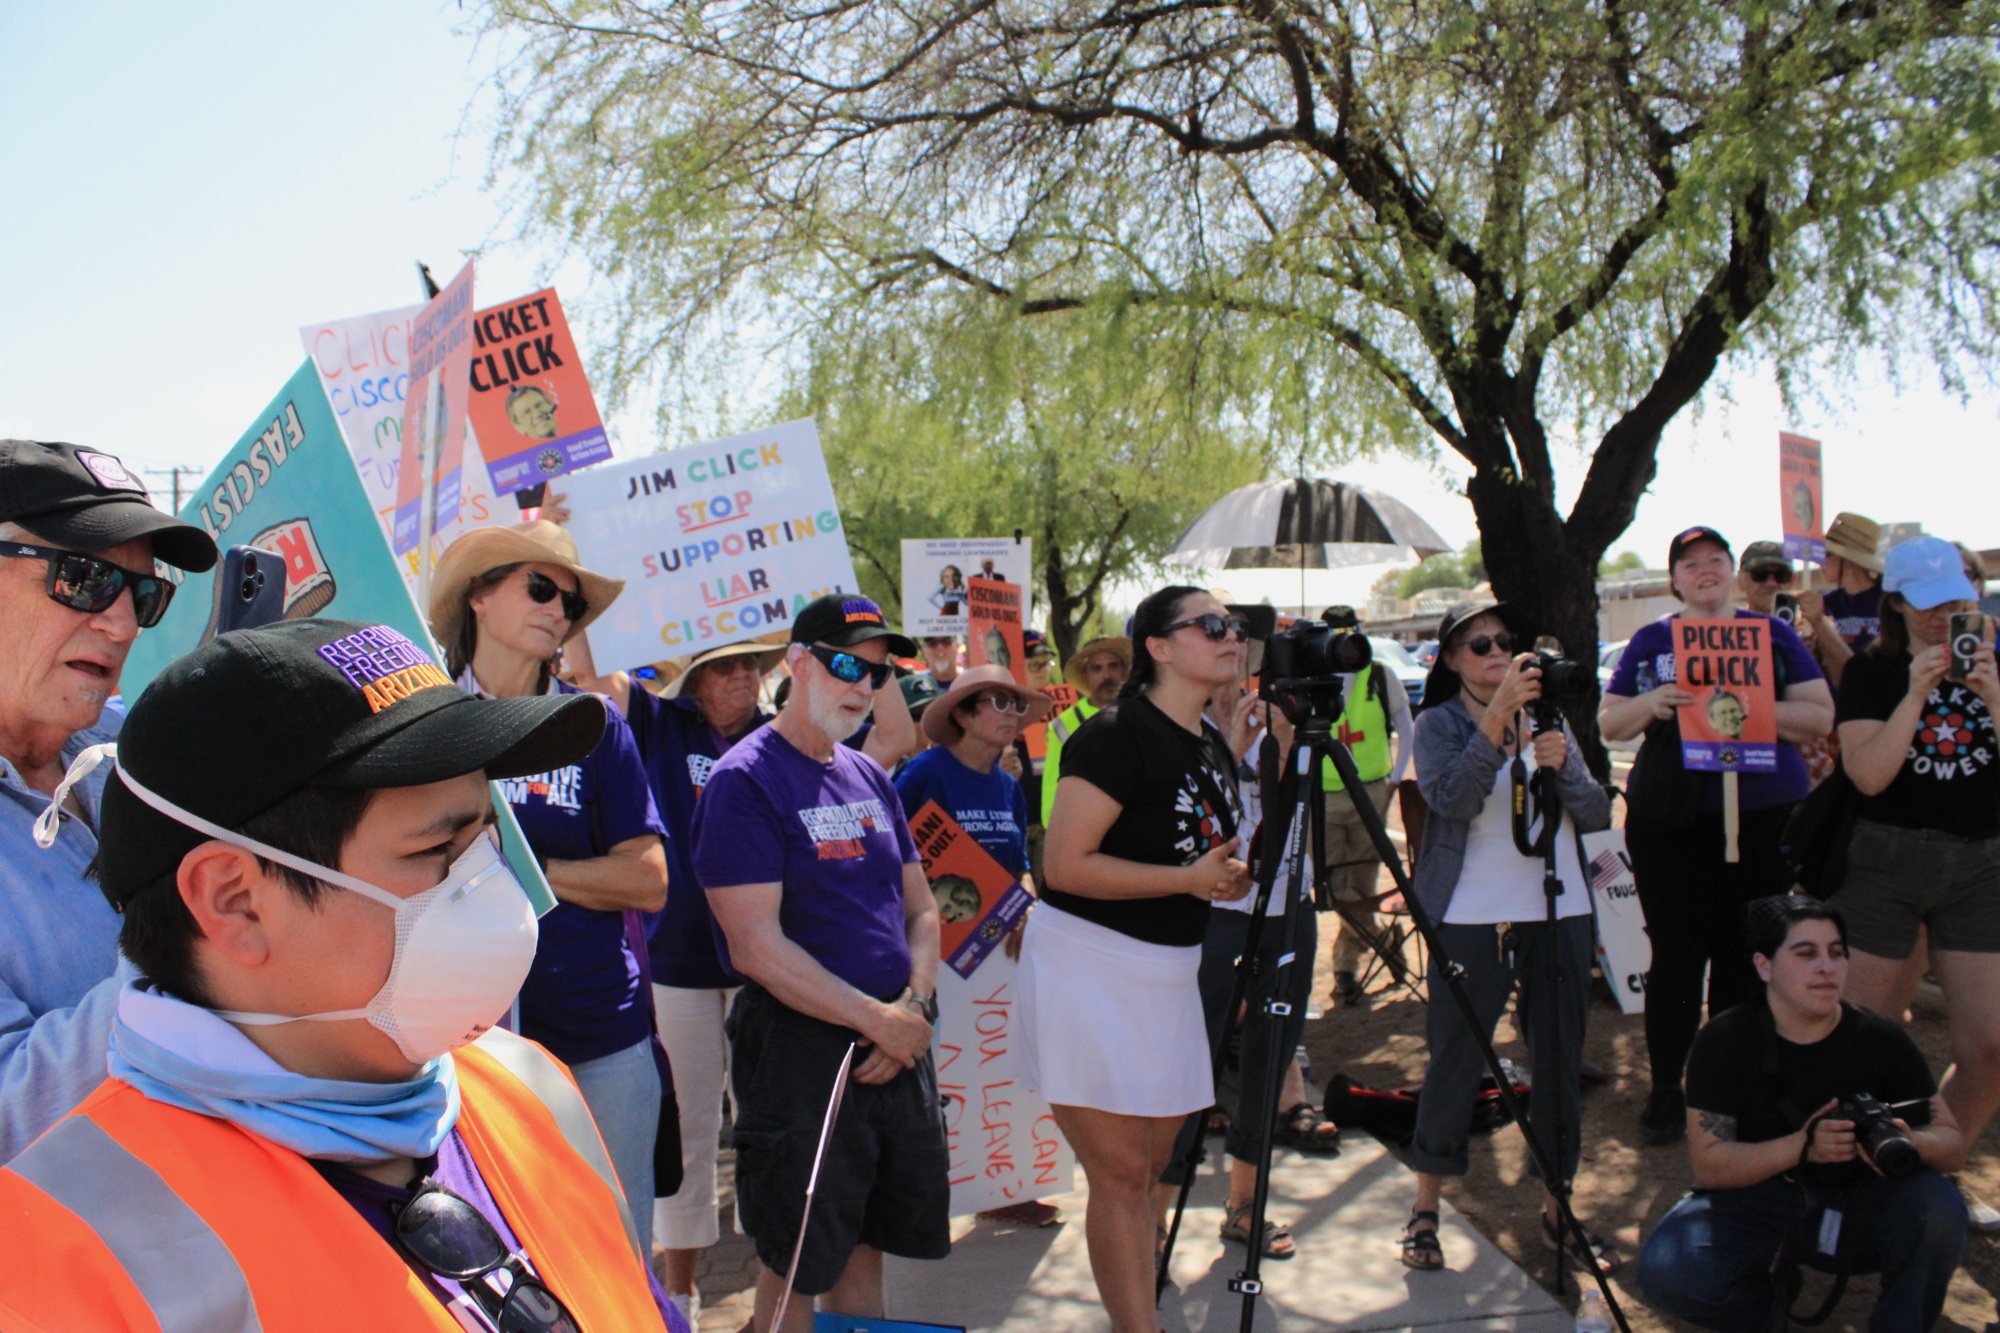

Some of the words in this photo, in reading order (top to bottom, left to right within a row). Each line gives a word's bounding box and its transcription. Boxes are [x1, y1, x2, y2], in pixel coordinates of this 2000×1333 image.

[473, 297, 551, 348] ICKET
[470, 333, 564, 393] CLICK
[627, 468, 677, 499] JIM
[687, 442, 782, 482] CLICK
[676, 490, 753, 528] STOP
[642, 510, 838, 579] SUPPORTING
[700, 568, 769, 606] LIAR
[1682, 625, 1761, 651] PICKET
[339, 642, 436, 689] FREEDOM
[1686, 656, 1761, 686] CLICK
[361, 663, 455, 715] ARIZONA
[1928, 687, 1994, 731] RKER
[546, 784, 582, 810] ALL
[798, 798, 886, 827] REPRODUCTIVE
[956, 810, 987, 820] MAKE
[1515, 784, 1524, 815] Nikon
[928, 828, 958, 859] OUT.
[1292, 801, 1305, 855] Manfrotto
[972, 983, 1012, 1067] YOU
[981, 1081, 1023, 1198] LEAVE?
[1031, 1113, 1060, 1185] CAN
